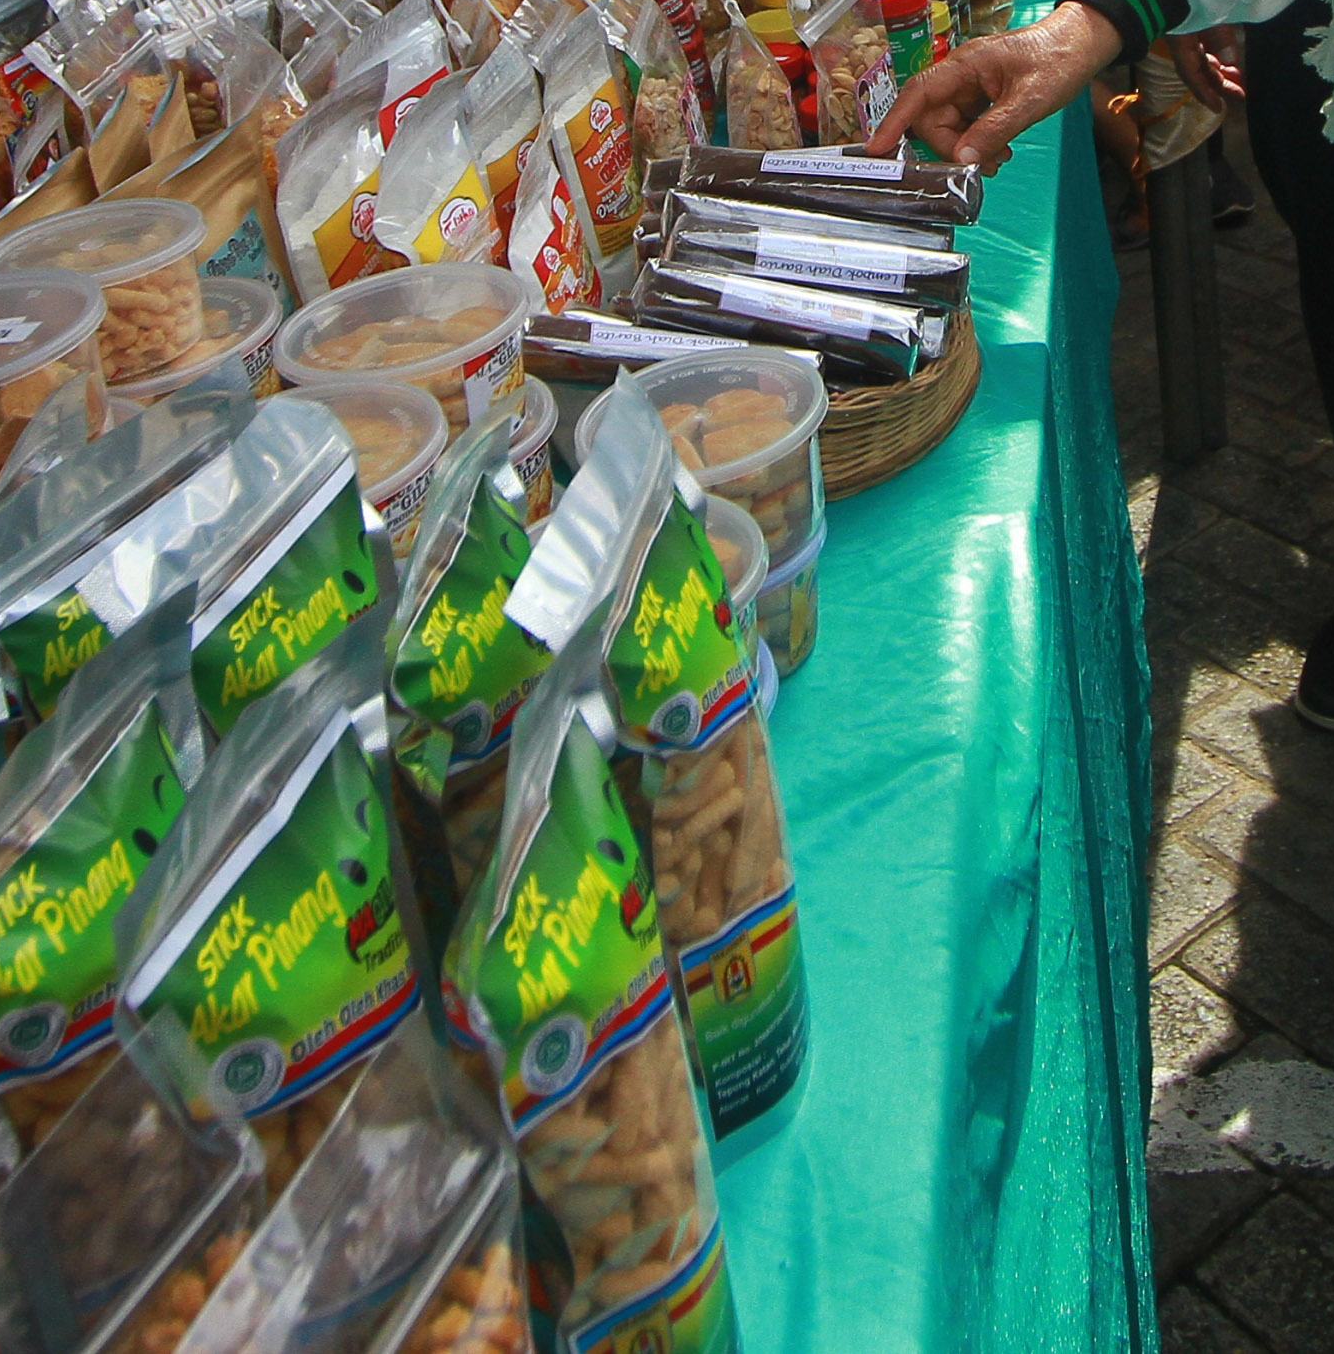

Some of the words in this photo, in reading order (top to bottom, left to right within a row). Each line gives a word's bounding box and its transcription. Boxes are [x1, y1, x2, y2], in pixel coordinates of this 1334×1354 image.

[767, 157, 809, 168] Barito
[810, 160, 845, 171] Diah
[847, 163, 898, 174] Lempok
[759, 259, 803, 275] Barito
[806, 266, 843, 279] Diah
[845, 270, 899, 285] Lempok
[595, 330, 642, 343] Barito
[643, 334, 679, 345] Diah
[221, 643, 279, 706] Akar
[271, 577, 347, 661] Pinang
[229, 586, 281, 653] STICK
[421, 591, 459, 657] STICK
[634, 580, 665, 649] STICK
[663, 567, 715, 653] Pinang
[33, 839, 136, 954] Pinang
[504, 872, 549, 969] STICK
[542, 852, 621, 968] Pinang
[196, 894, 255, 988] STICK
[246, 870, 348, 991] Pinang
[291, 1018, 336, 1063] Oleh
[338, 990, 375, 1026] Oleh
